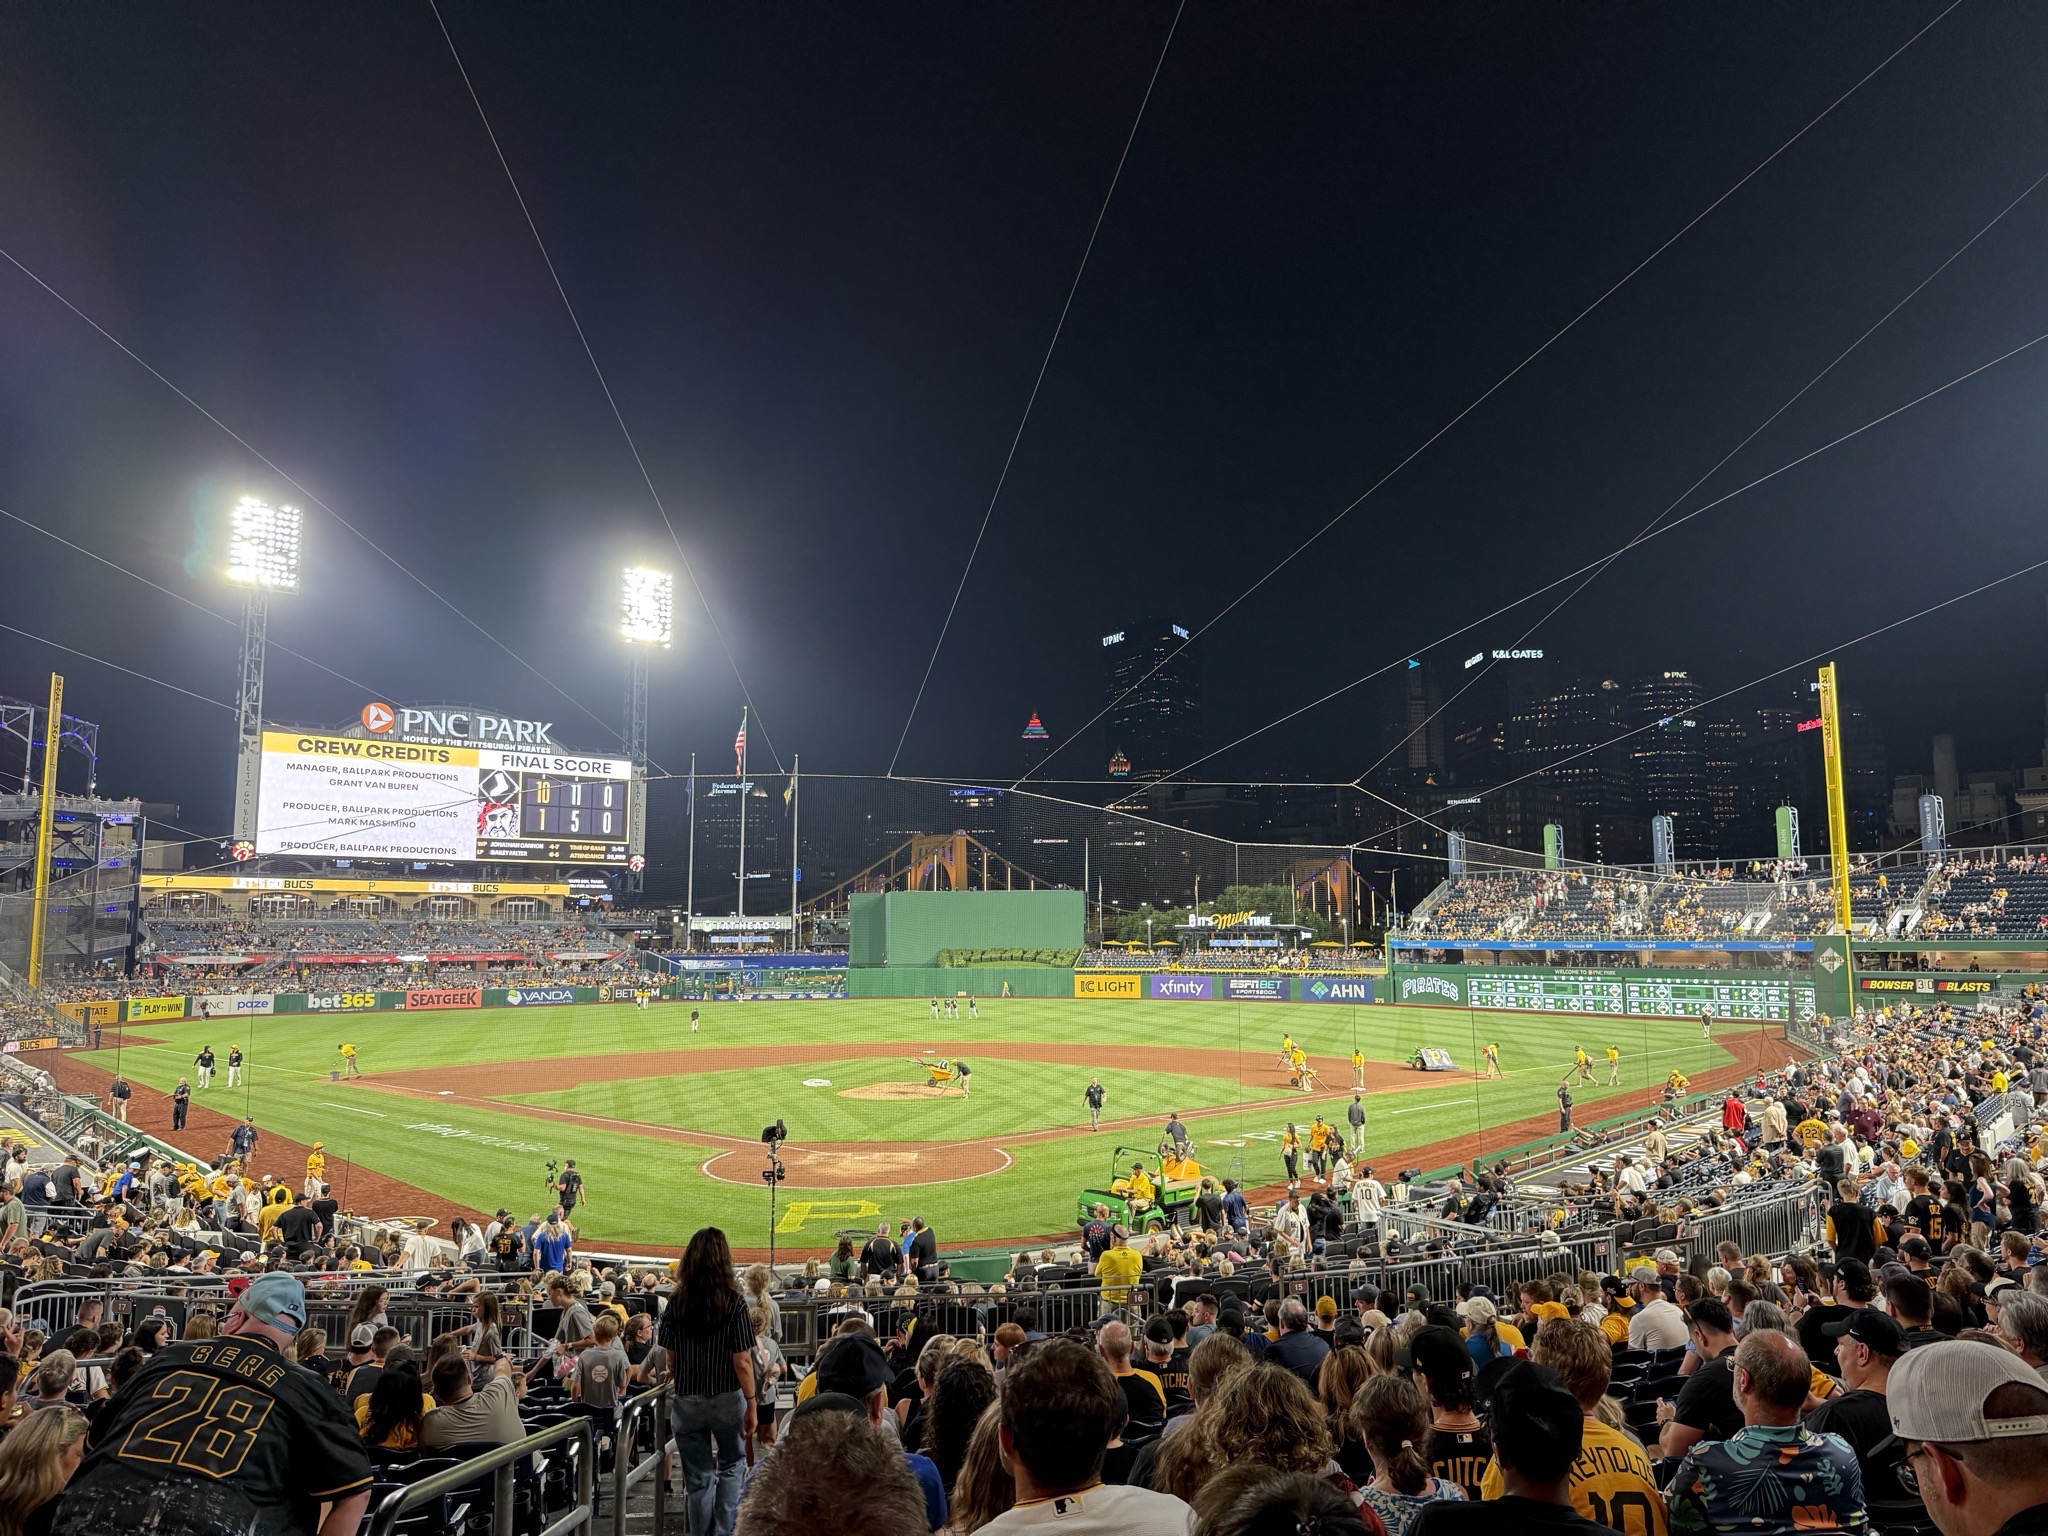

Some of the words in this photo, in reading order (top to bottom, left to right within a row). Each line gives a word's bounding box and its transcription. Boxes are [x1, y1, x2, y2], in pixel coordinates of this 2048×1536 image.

[1173, 624, 1190, 640] UPMC
[1102, 632, 1125, 647] UPMC
[1492, 650, 1511, 659] K&L
[1512, 650, 1544, 659] GATES
[1671, 671, 1688, 679] PNC
[400, 709, 469, 738] PNC
[476, 715, 553, 745] PARK
[297, 738, 362, 756] CREW
[366, 744, 450, 763] CREDITS
[402, 734, 429, 744] HOME
[430, 737, 444, 745] OF
[444, 738, 462, 747] THE
[463, 739, 516, 752] PITTSBURGH
[517, 745, 551, 754] PIRATES
[501, 754, 550, 770] FINAL
[553, 758, 612, 774] SCORE
[286, 763, 341, 775] MANAGER,
[342, 766, 391, 777] BALLPARK
[392, 770, 459, 782] PRODUCTIONS
[329, 778, 363, 788] GRANT
[364, 780, 386, 789] VAN
[387, 782, 419, 791] BUREN
[243, 791, 251, 805] GO
[536, 781, 551, 804] 10
[571, 784, 582, 806] 11
[603, 785, 612, 808] 0
[1447, 797, 1481, 805] RENAISSANCE
[282, 801, 341, 813] PRODUCER,
[342, 805, 391, 815] BALLPARK
[392, 808, 459, 818] PRODUCTIONS
[242, 808, 250, 838] BUCS
[328, 817, 358, 826] MARK
[359, 819, 417, 829] MASSIMINO
[539, 808, 545, 831] 1
[570, 810, 580, 833] 5
[602, 811, 612, 834] 0
[280, 841, 338, 853] PRODUCER,
[340, 843, 389, 854] BALLPARK
[390, 845, 457, 855] PRODUCTIONS
[569, 852, 605, 860] ATTENDANCE
[166, 877, 174, 887] P
[283, 880, 314, 889] BUCS
[368, 881, 375, 890] P
[472, 884, 499, 893] BUCS
[716, 922, 735, 930] FAT
[735, 921, 781, 930] HEAD'S
[1197, 917, 1213, 926] IT'S
[1210, 910, 1257, 930] Miller
[1249, 916, 1271, 926] TIME
[1080, 980, 1095, 992] IC
[1097, 981, 1136, 992] LIGHT
[1160, 979, 1204, 996] xfinity
[1646, 977, 1720, 985] AMERICAN
[1870, 980, 1914, 990] BOWSER
[1946, 982, 1991, 992] BLASTS
[522, 990, 573, 1001] VANDA
[1330, 984, 1365, 999] AHN
[1402, 976, 1459, 1002] PIRATES
[237, 1000, 269, 1011] paze
[307, 993, 376, 1010] bet365
[410, 991, 478, 1007] SEATGEEK
[144, 1004, 161, 1015] PLAY
[167, 1002, 183, 1012] WIN!
[19, 1040, 40, 1051] BUCS
[2010, 1098, 2022, 1108] 35
[1804, 1128, 1818, 1139] 22
[1360, 1188, 1373, 1201] 10
[770, 1200, 884, 1234] P
[1928, 1217, 1942, 1240] 15
[1597, 1244, 1606, 1253] 15
[1294, 1283, 1303, 1291] 15
[1133, 1294, 1143, 1302] 16
[118, 1303, 127, 1311] 17
[505, 1314, 516, 1324] 17
[189, 1345, 286, 1388] BERG
[118, 1369, 275, 1479] 28
